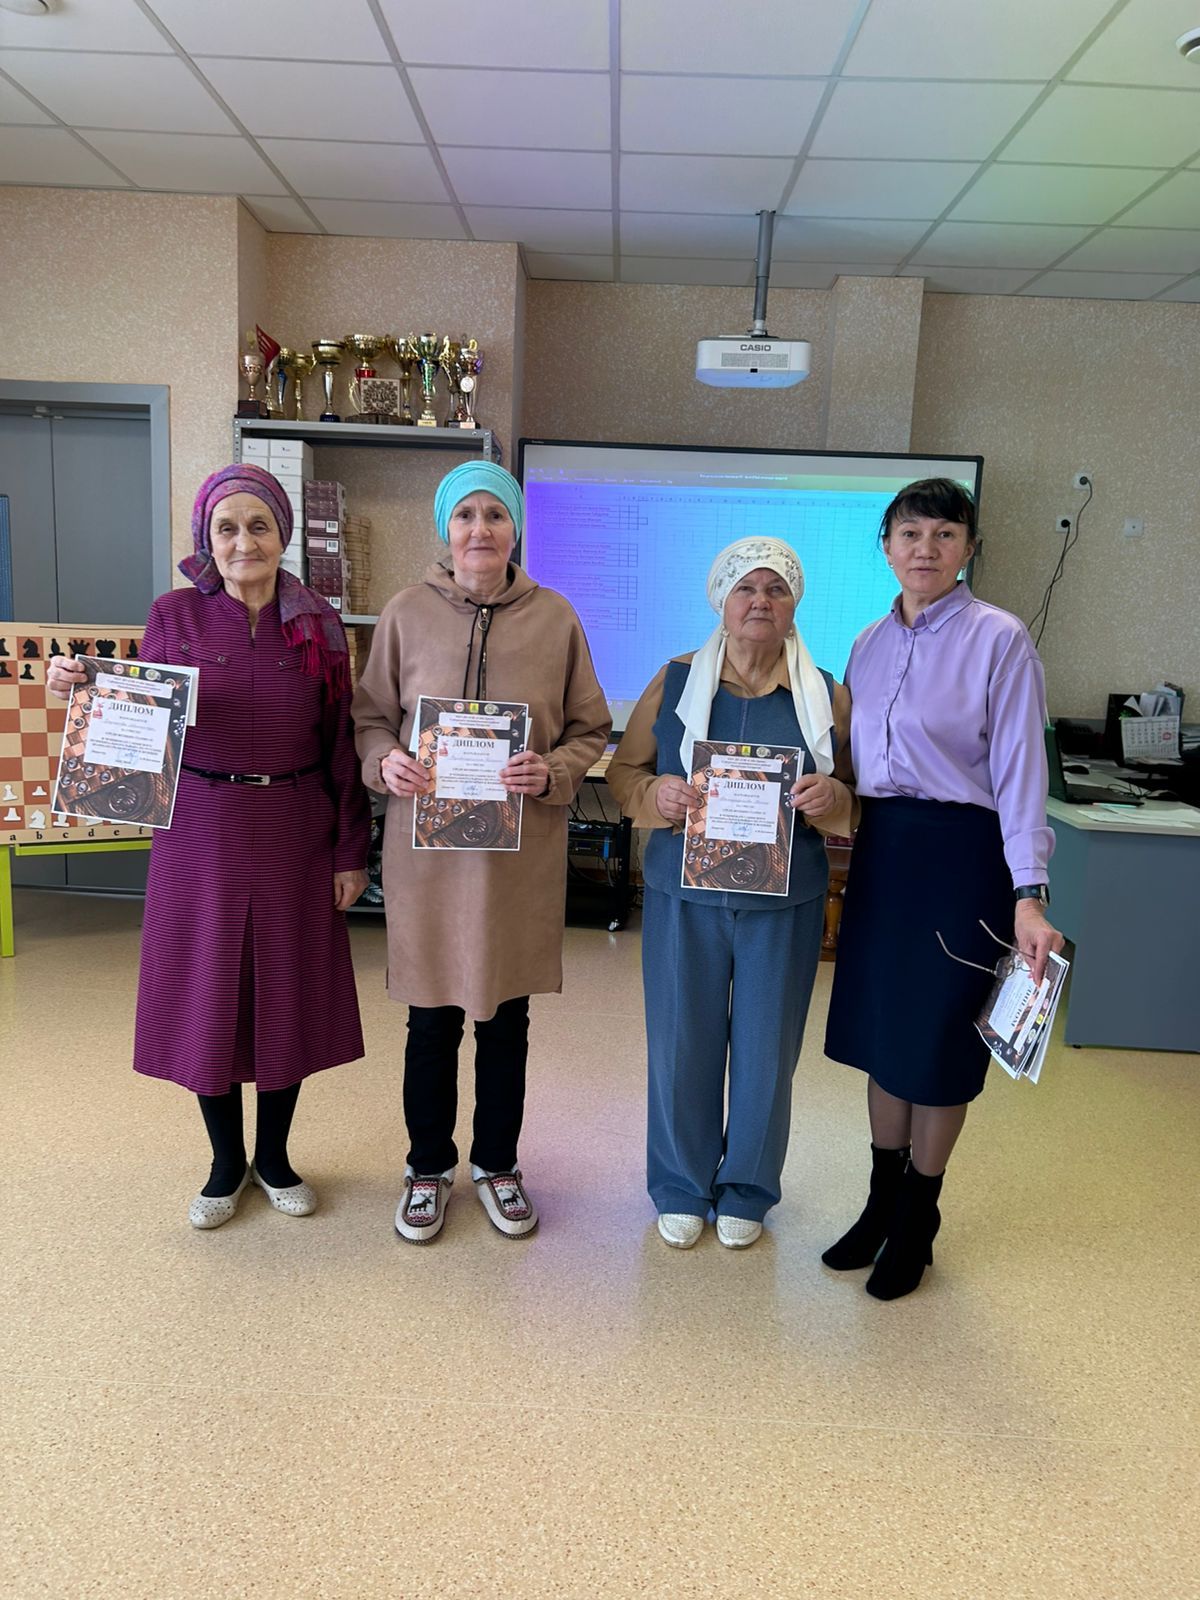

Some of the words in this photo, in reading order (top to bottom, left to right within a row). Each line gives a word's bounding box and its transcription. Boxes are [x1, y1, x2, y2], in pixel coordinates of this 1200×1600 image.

[740, 344, 772, 352] CASIO
[108, 702, 154, 716] ДИПЛОМ
[452, 739, 495, 749] ДИПЛОМ
[723, 781, 766, 791] ДИПЛОМ
[36, 831, 43, 840] b
[88, 829, 95, 837] d
[138, 826, 145, 835] f
